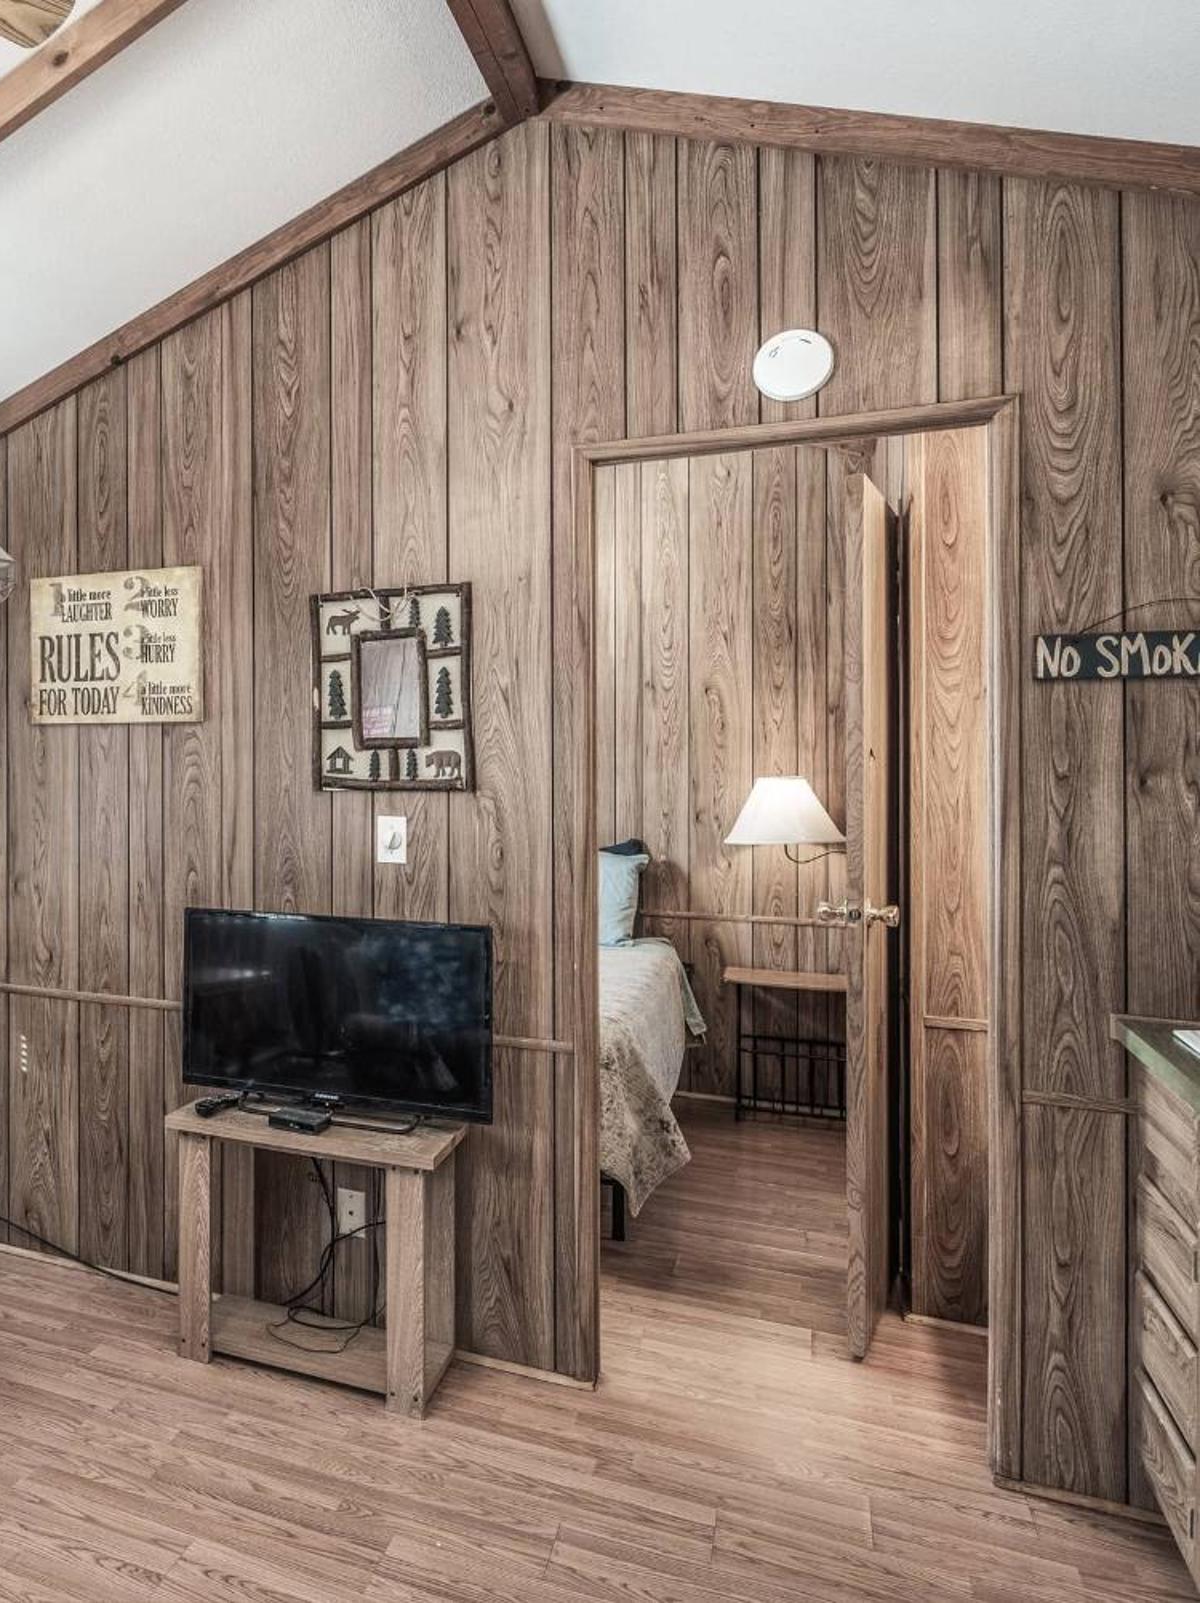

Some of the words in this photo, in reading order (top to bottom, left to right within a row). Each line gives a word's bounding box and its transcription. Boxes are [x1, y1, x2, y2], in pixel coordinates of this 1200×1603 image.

[68, 588, 88, 602] little
[89, 589, 112, 601] more
[123, 576, 149, 612] 2
[164, 585, 179, 597] less
[61, 601, 113, 624] LAUGHTER
[141, 598, 179, 618] WORRY
[122, 624, 149, 661] 3
[162, 632, 177, 642] less
[39, 631, 121, 684] RULES
[140, 644, 176, 664] HURRY
[1036, 634, 1082, 679] No
[1095, 632, 1200, 678] SMoK
[122, 669, 147, 706] 4
[148, 681, 168, 695] little
[169, 683, 192, 695] more
[39, 688, 68, 717] FOR
[72, 686, 120, 717] TODAY
[140, 695, 193, 716] KINDNESS
